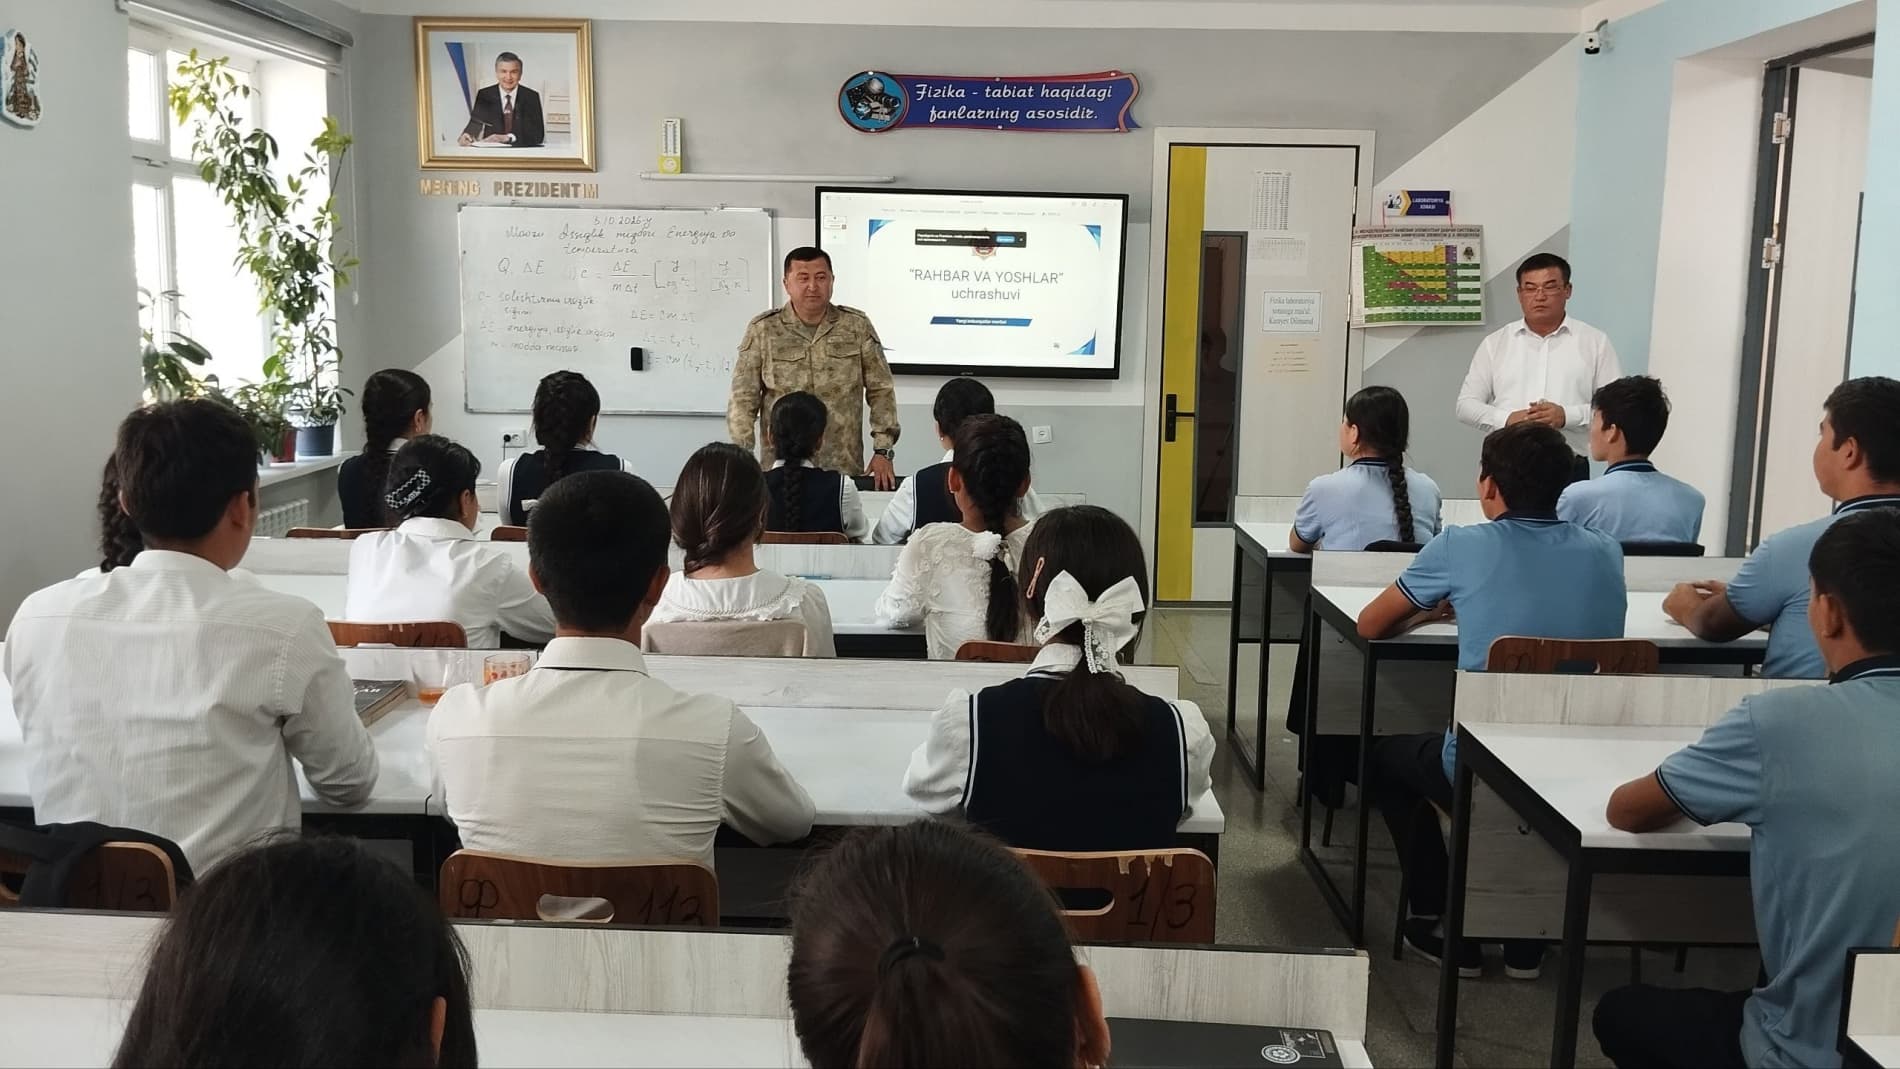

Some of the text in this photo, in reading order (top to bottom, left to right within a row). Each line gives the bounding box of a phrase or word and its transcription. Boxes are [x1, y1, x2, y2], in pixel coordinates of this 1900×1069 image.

[915, 84, 966, 101] Fizika
[985, 84, 1034, 98] tabiat
[1041, 84, 1113, 102] haqidagi
[929, 105, 1099, 123] fanlarning asosidir.
[974, 270, 991, 282] VA
[951, 288, 1021, 301] uchrashuvi
[1127, 868, 1198, 942] 1/3
